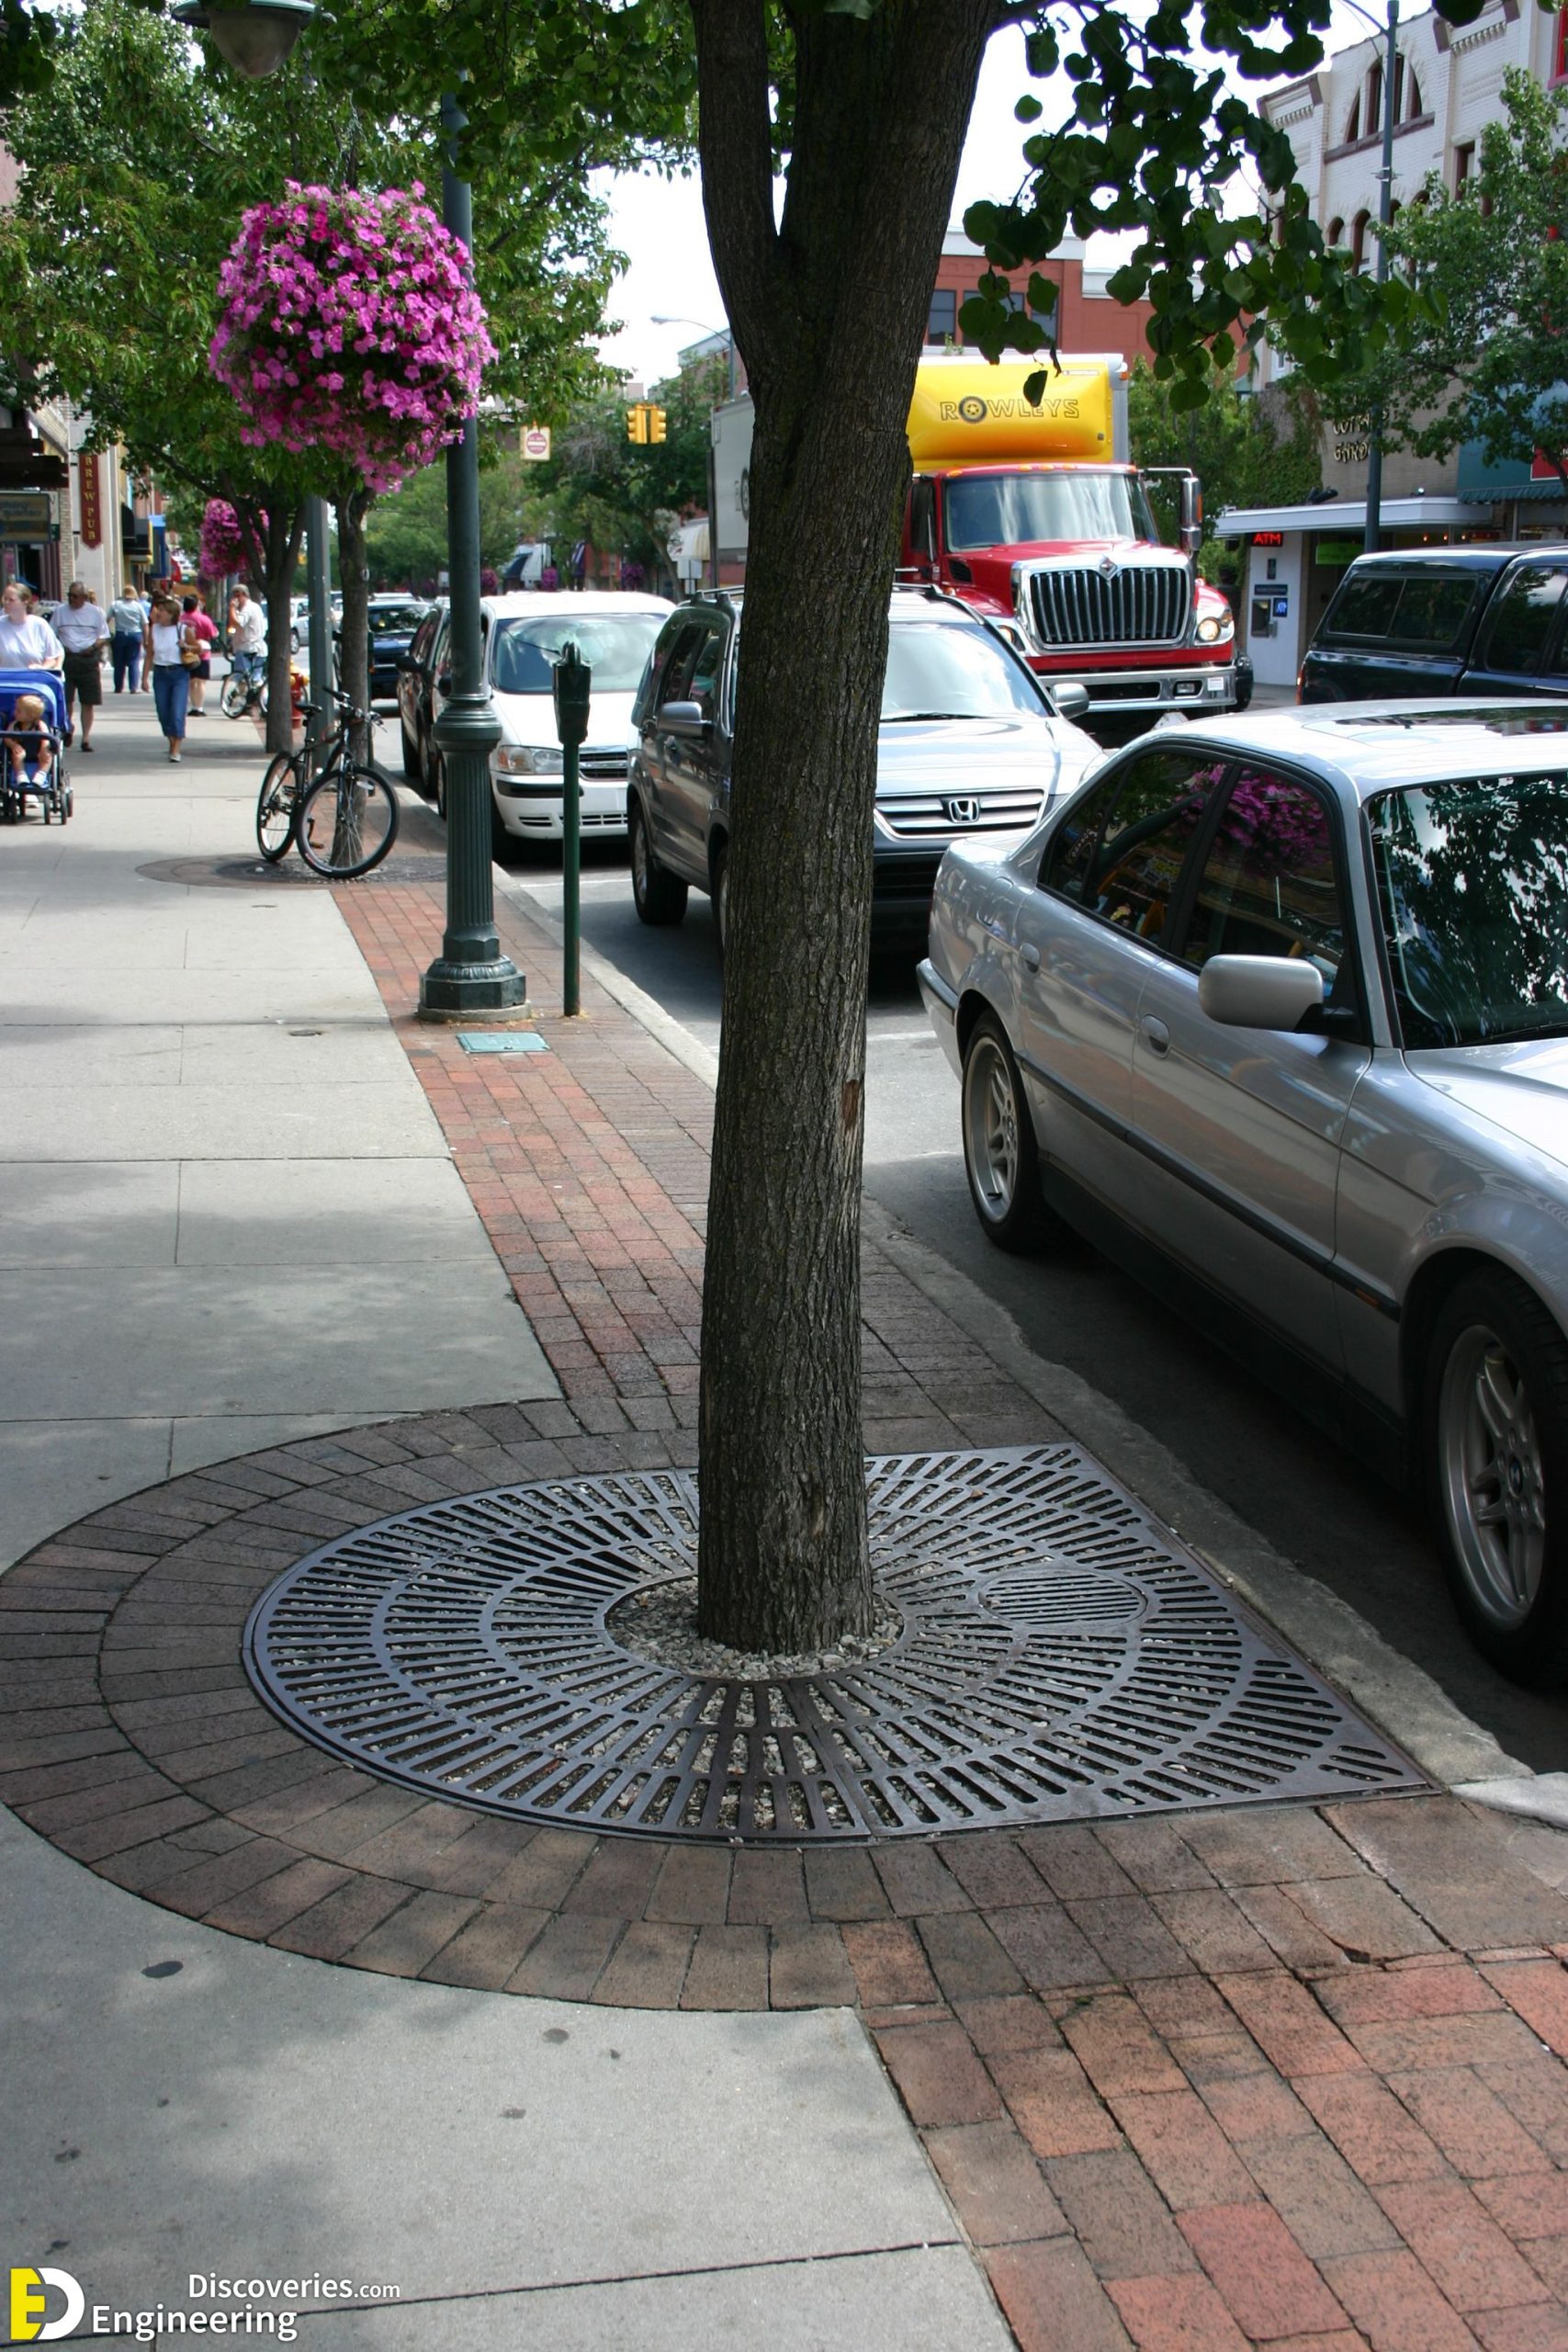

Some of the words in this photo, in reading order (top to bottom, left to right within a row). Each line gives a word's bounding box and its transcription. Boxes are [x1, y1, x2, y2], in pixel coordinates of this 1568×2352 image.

[940, 396, 1079, 424] ROWLEYS
[84, 456, 96, 501] BREW
[87, 507, 96, 541] PUB
[1253, 532, 1281, 545] ATM
